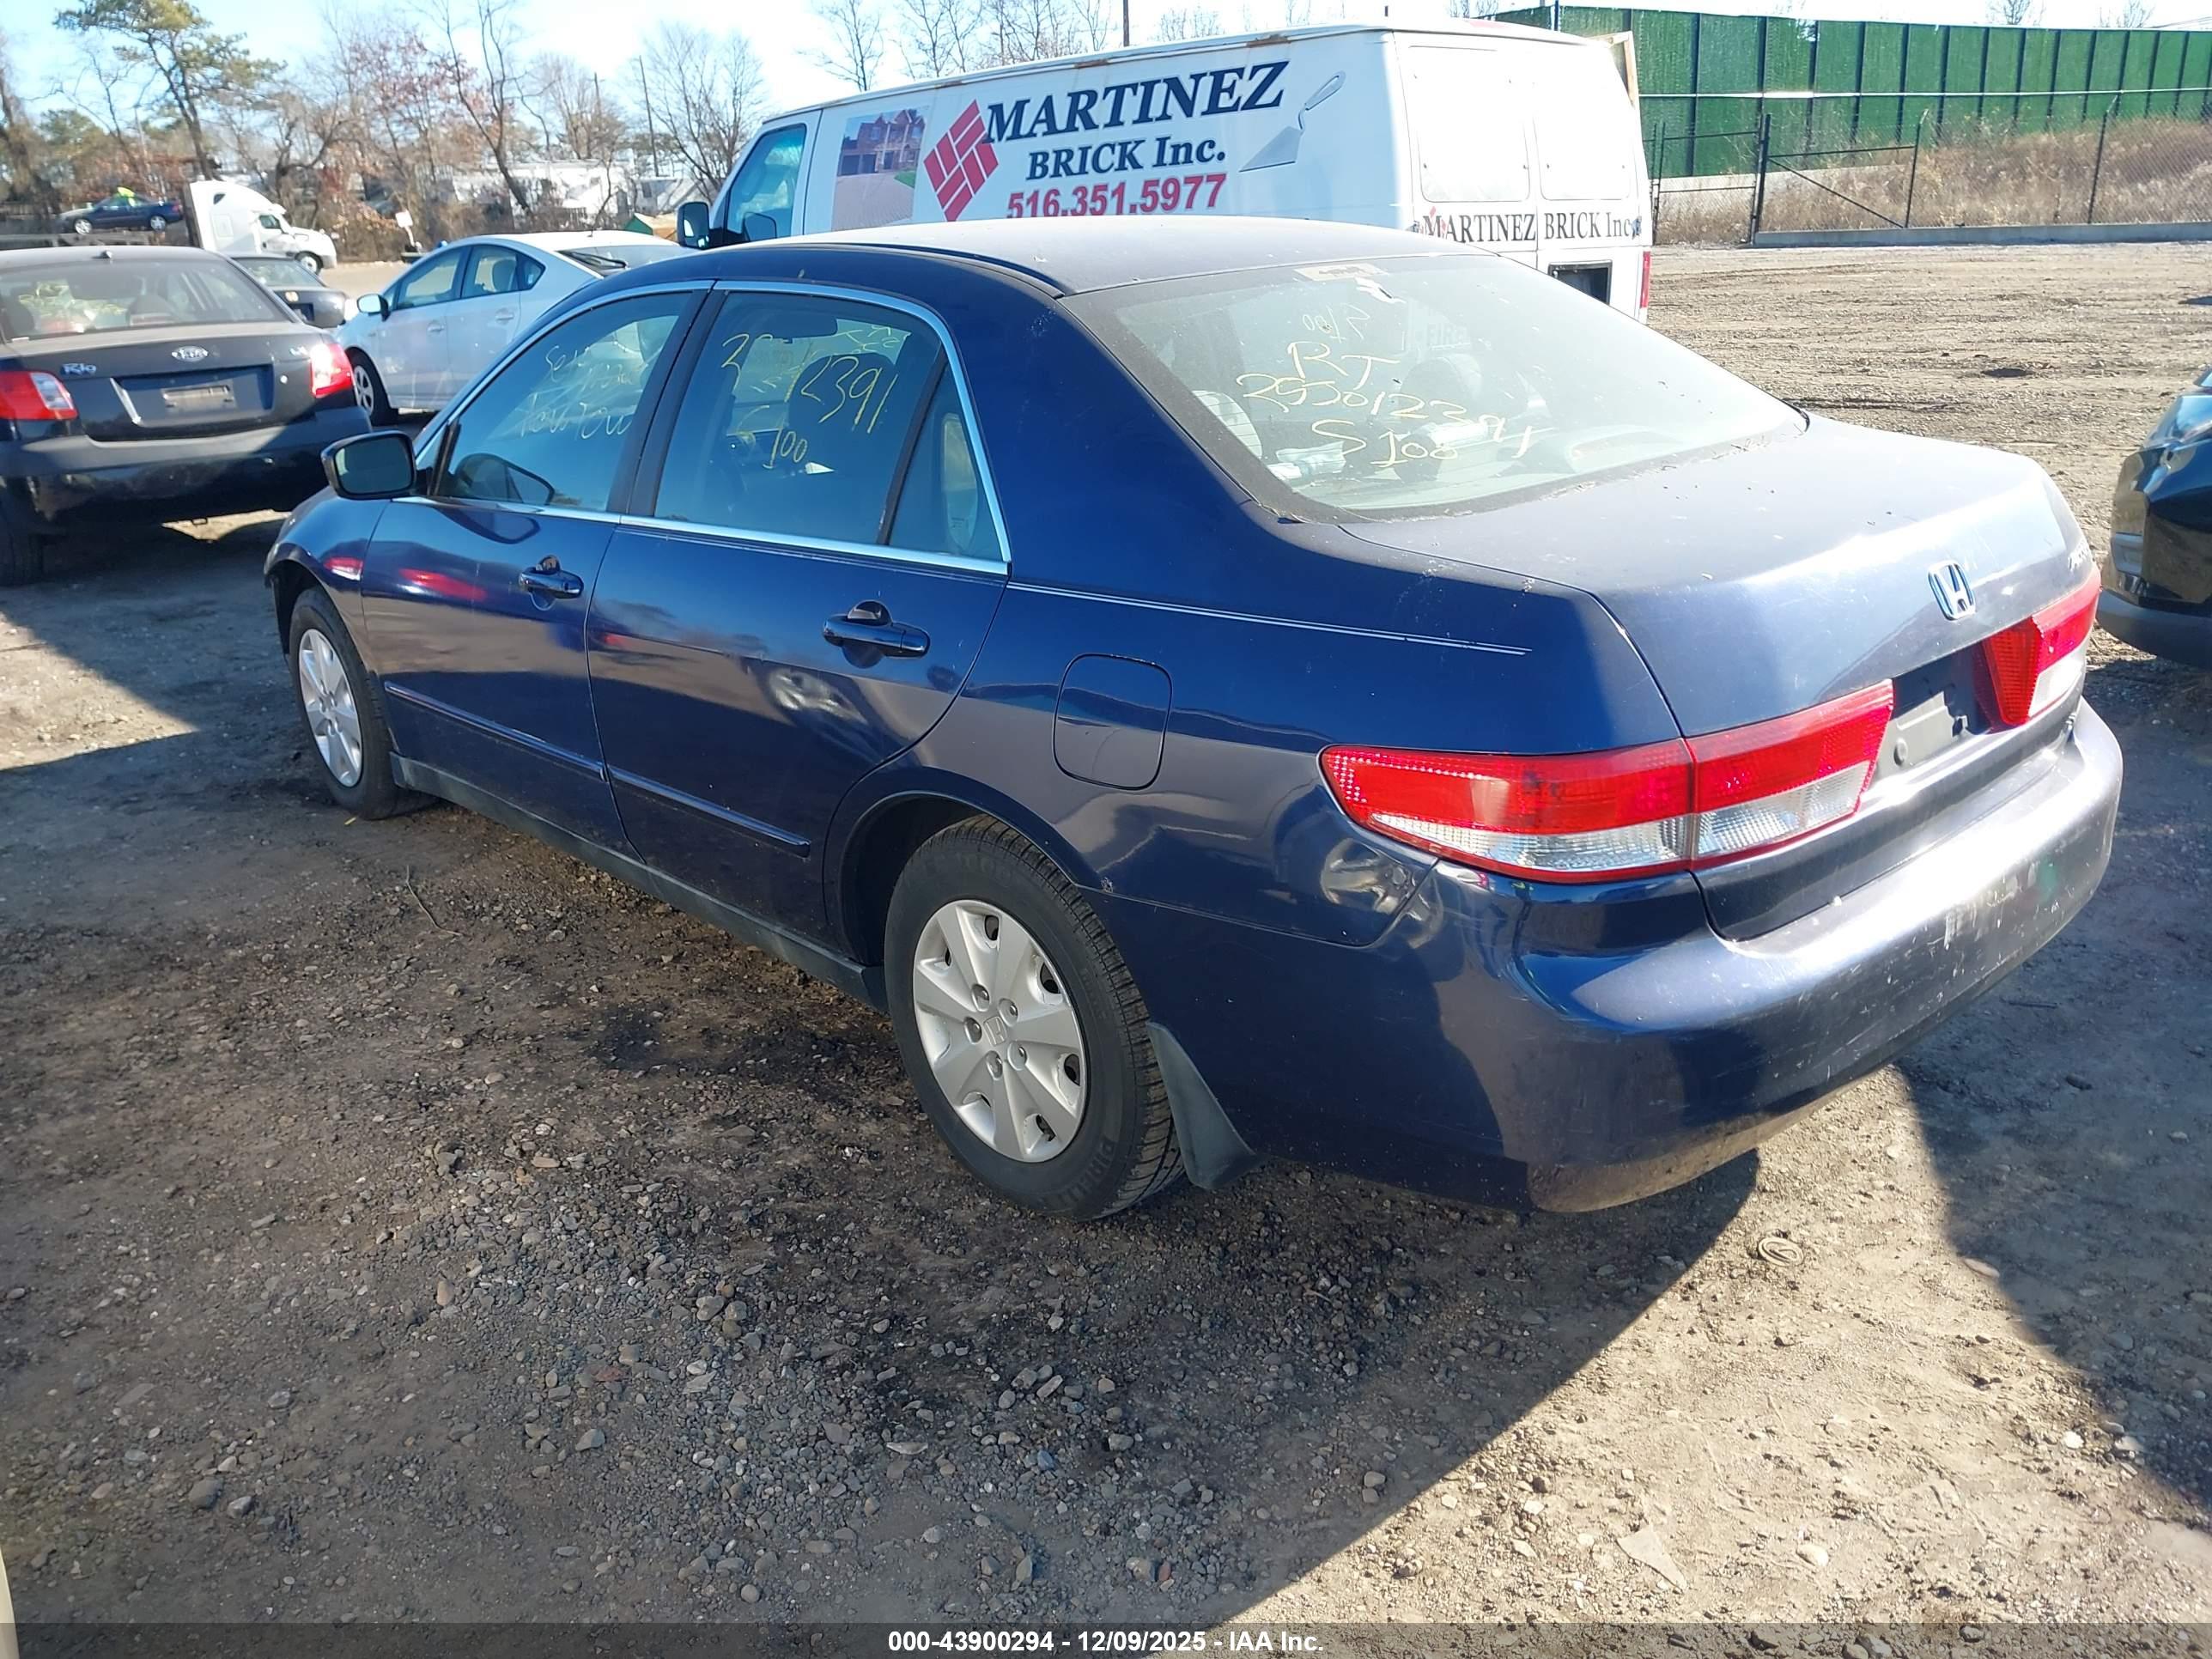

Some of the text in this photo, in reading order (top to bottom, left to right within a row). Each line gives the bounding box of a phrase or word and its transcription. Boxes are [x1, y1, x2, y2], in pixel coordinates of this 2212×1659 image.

[982, 60, 1290, 144] MARTINEZ
[1026, 136, 1225, 180] BRICK Inc.
[1006, 173, 1227, 218] 516.351.5977
[1423, 214, 1536, 243] MARTINEZ
[1544, 211, 1601, 240] BRICK
